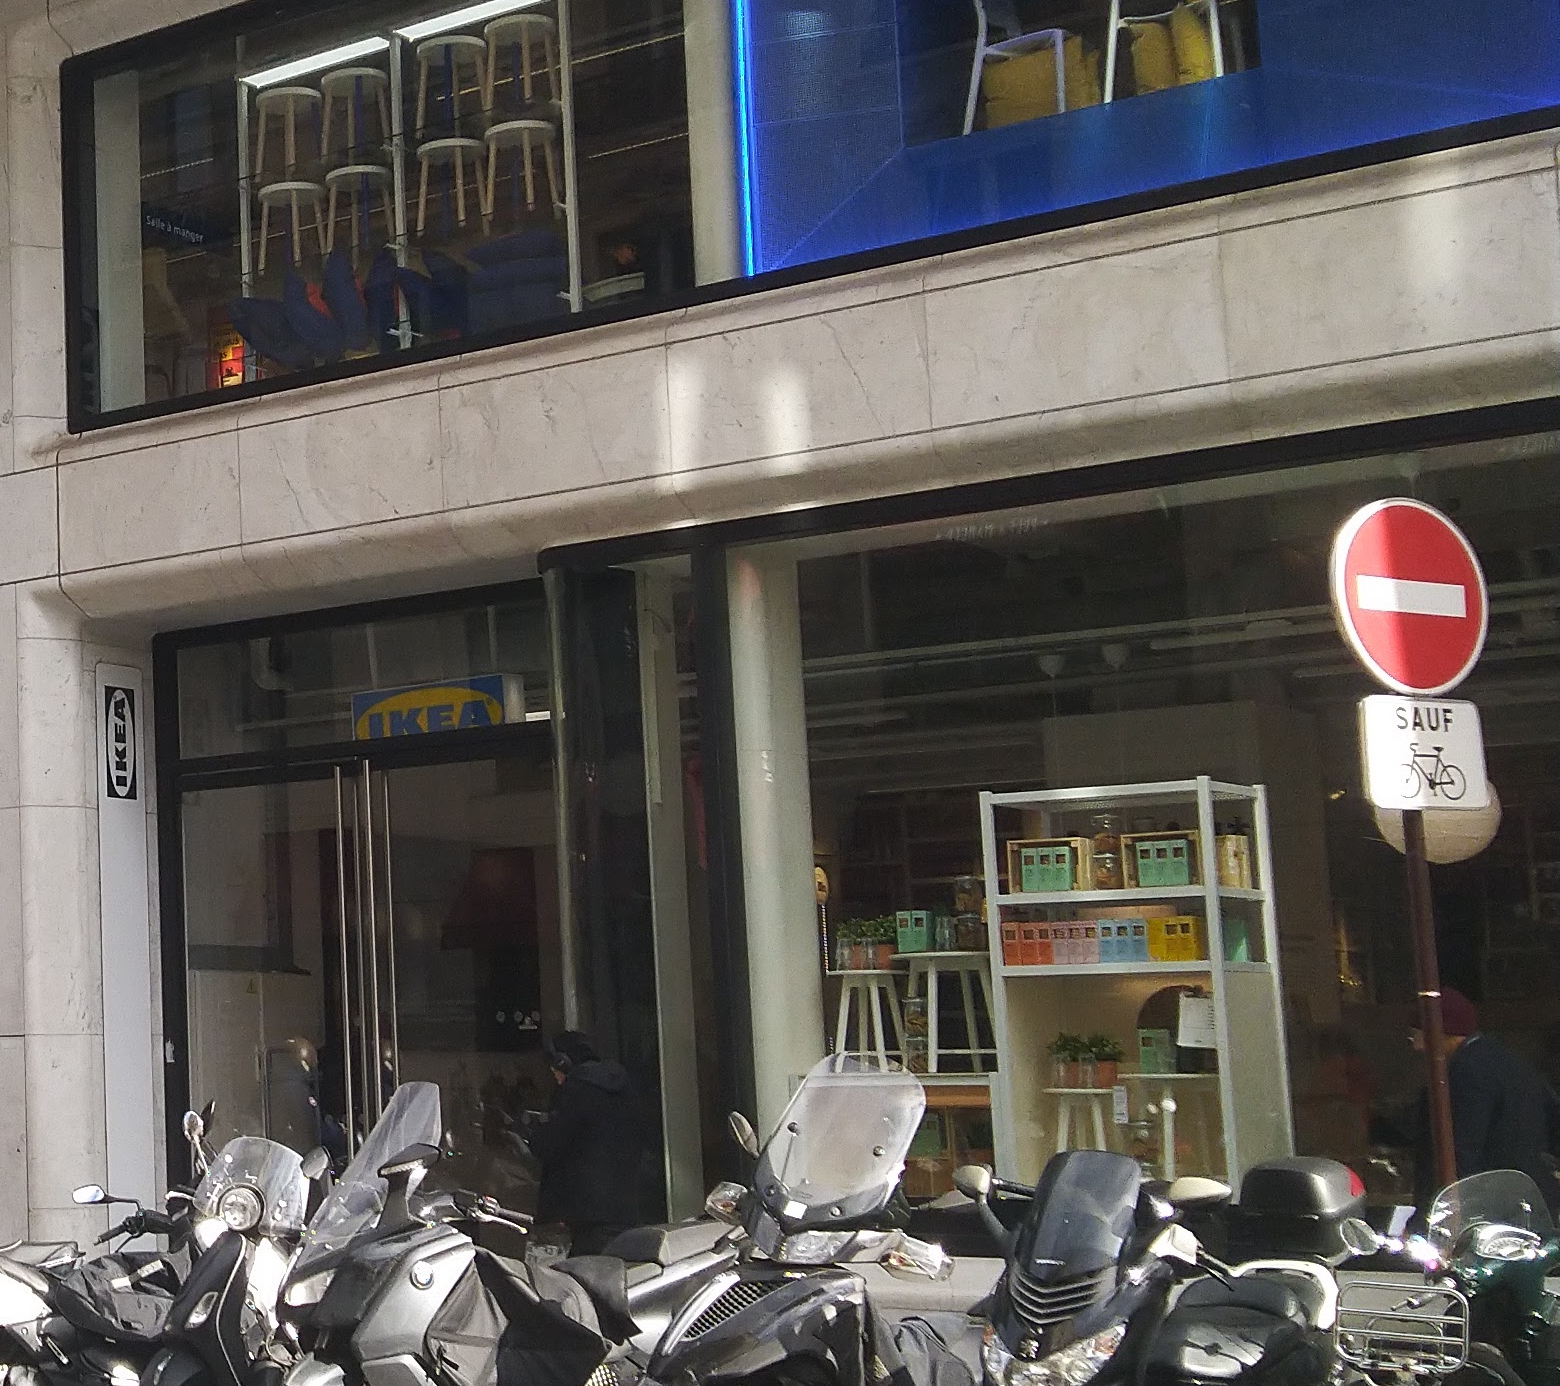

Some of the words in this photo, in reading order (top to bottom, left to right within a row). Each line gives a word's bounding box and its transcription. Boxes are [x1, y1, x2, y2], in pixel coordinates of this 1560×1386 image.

[369, 699, 495, 738] IKEA
[1395, 706, 1454, 733] SAUF
[114, 697, 128, 788] IKEA
